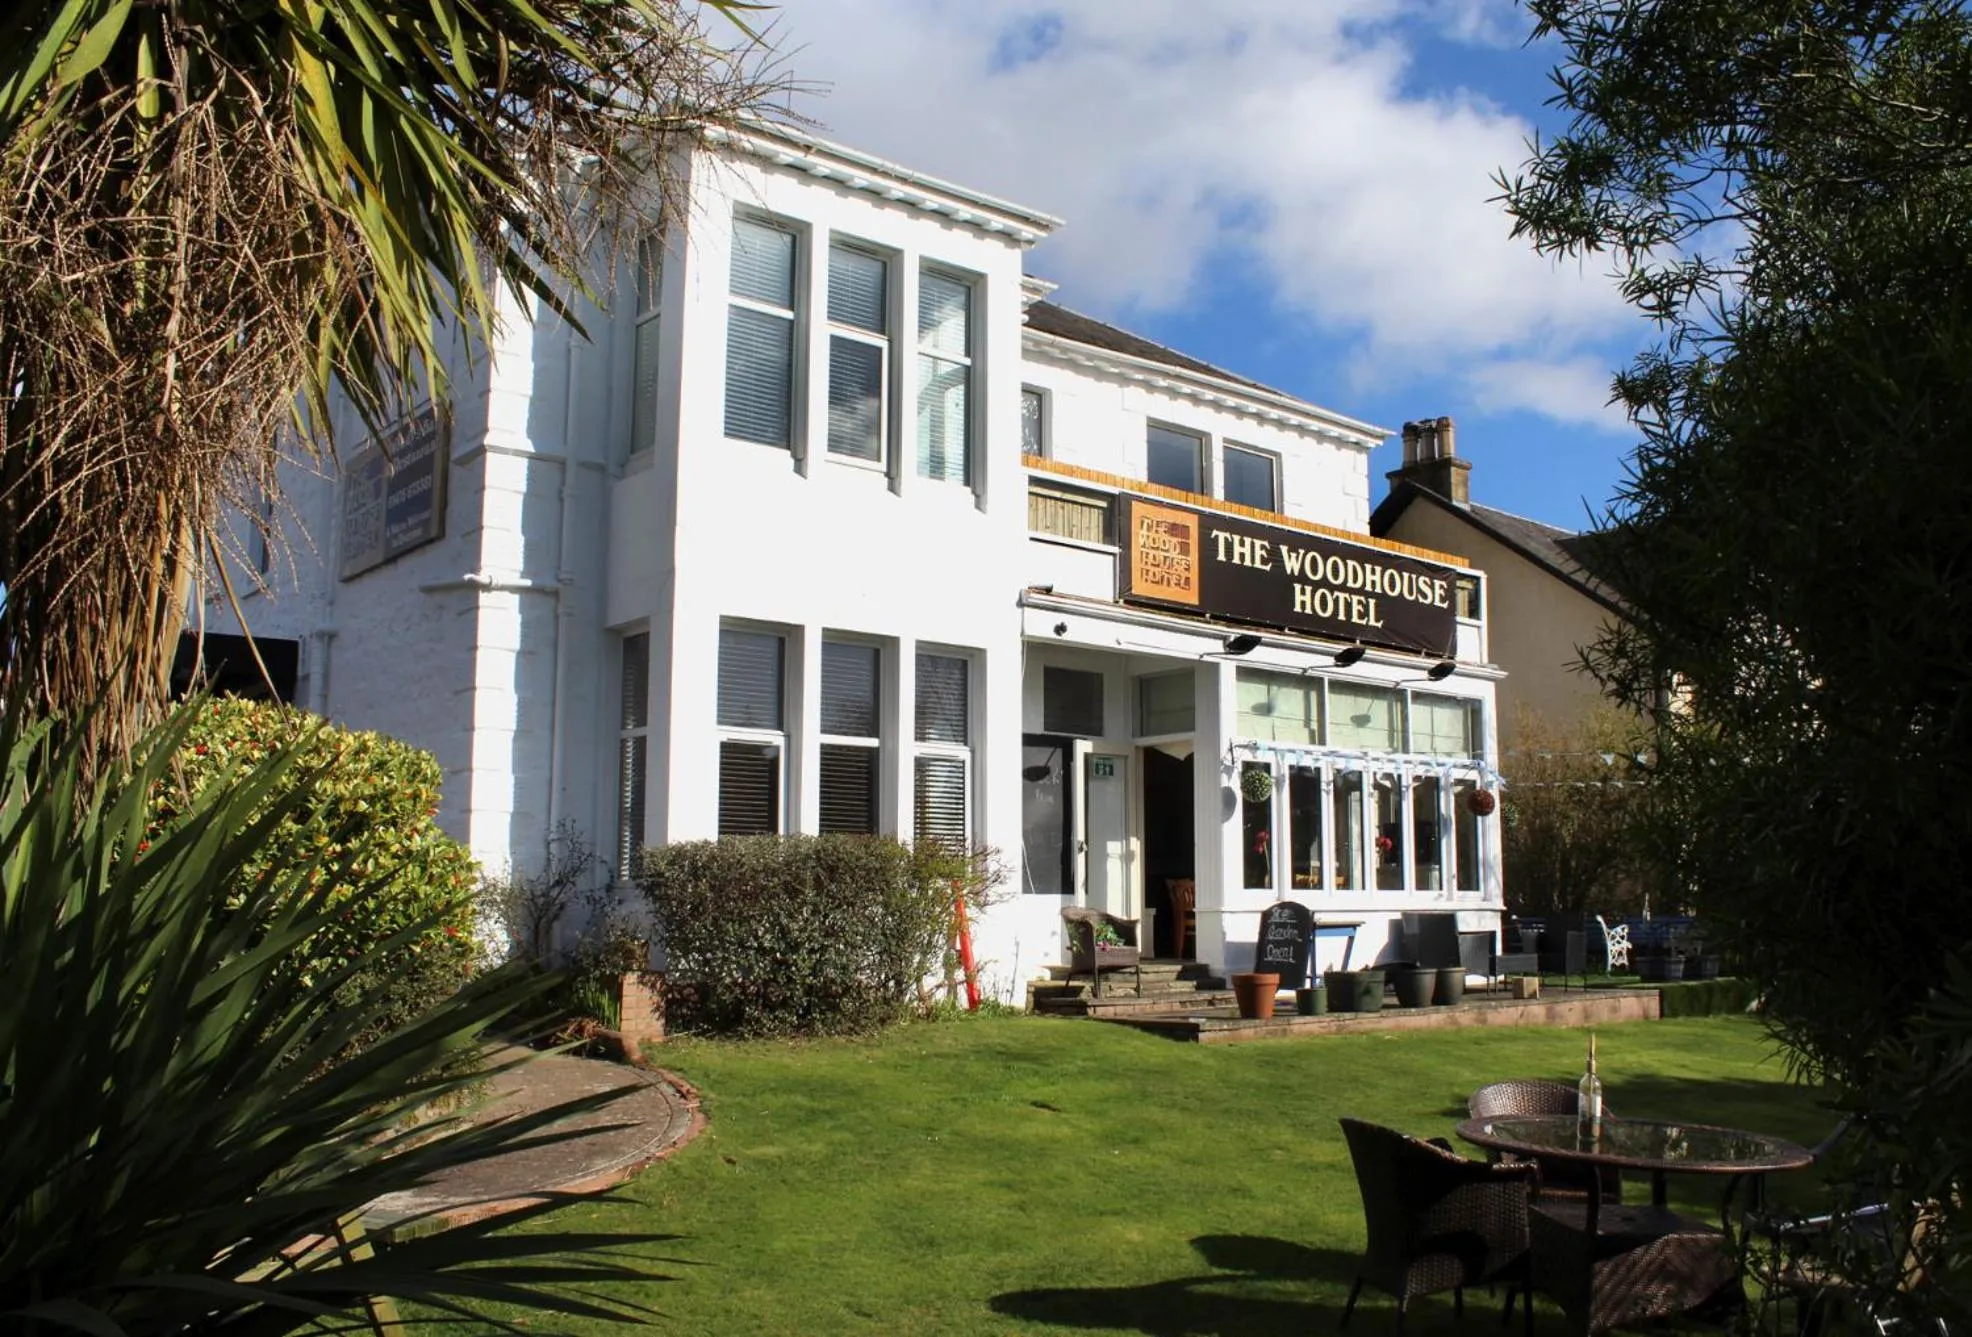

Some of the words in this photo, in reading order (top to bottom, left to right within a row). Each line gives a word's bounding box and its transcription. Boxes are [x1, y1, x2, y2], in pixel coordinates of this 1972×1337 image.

[1211, 529, 1272, 572] THE
[1279, 544, 1449, 609] WOODHOUSE
[1293, 583, 1384, 629] HOTEL
